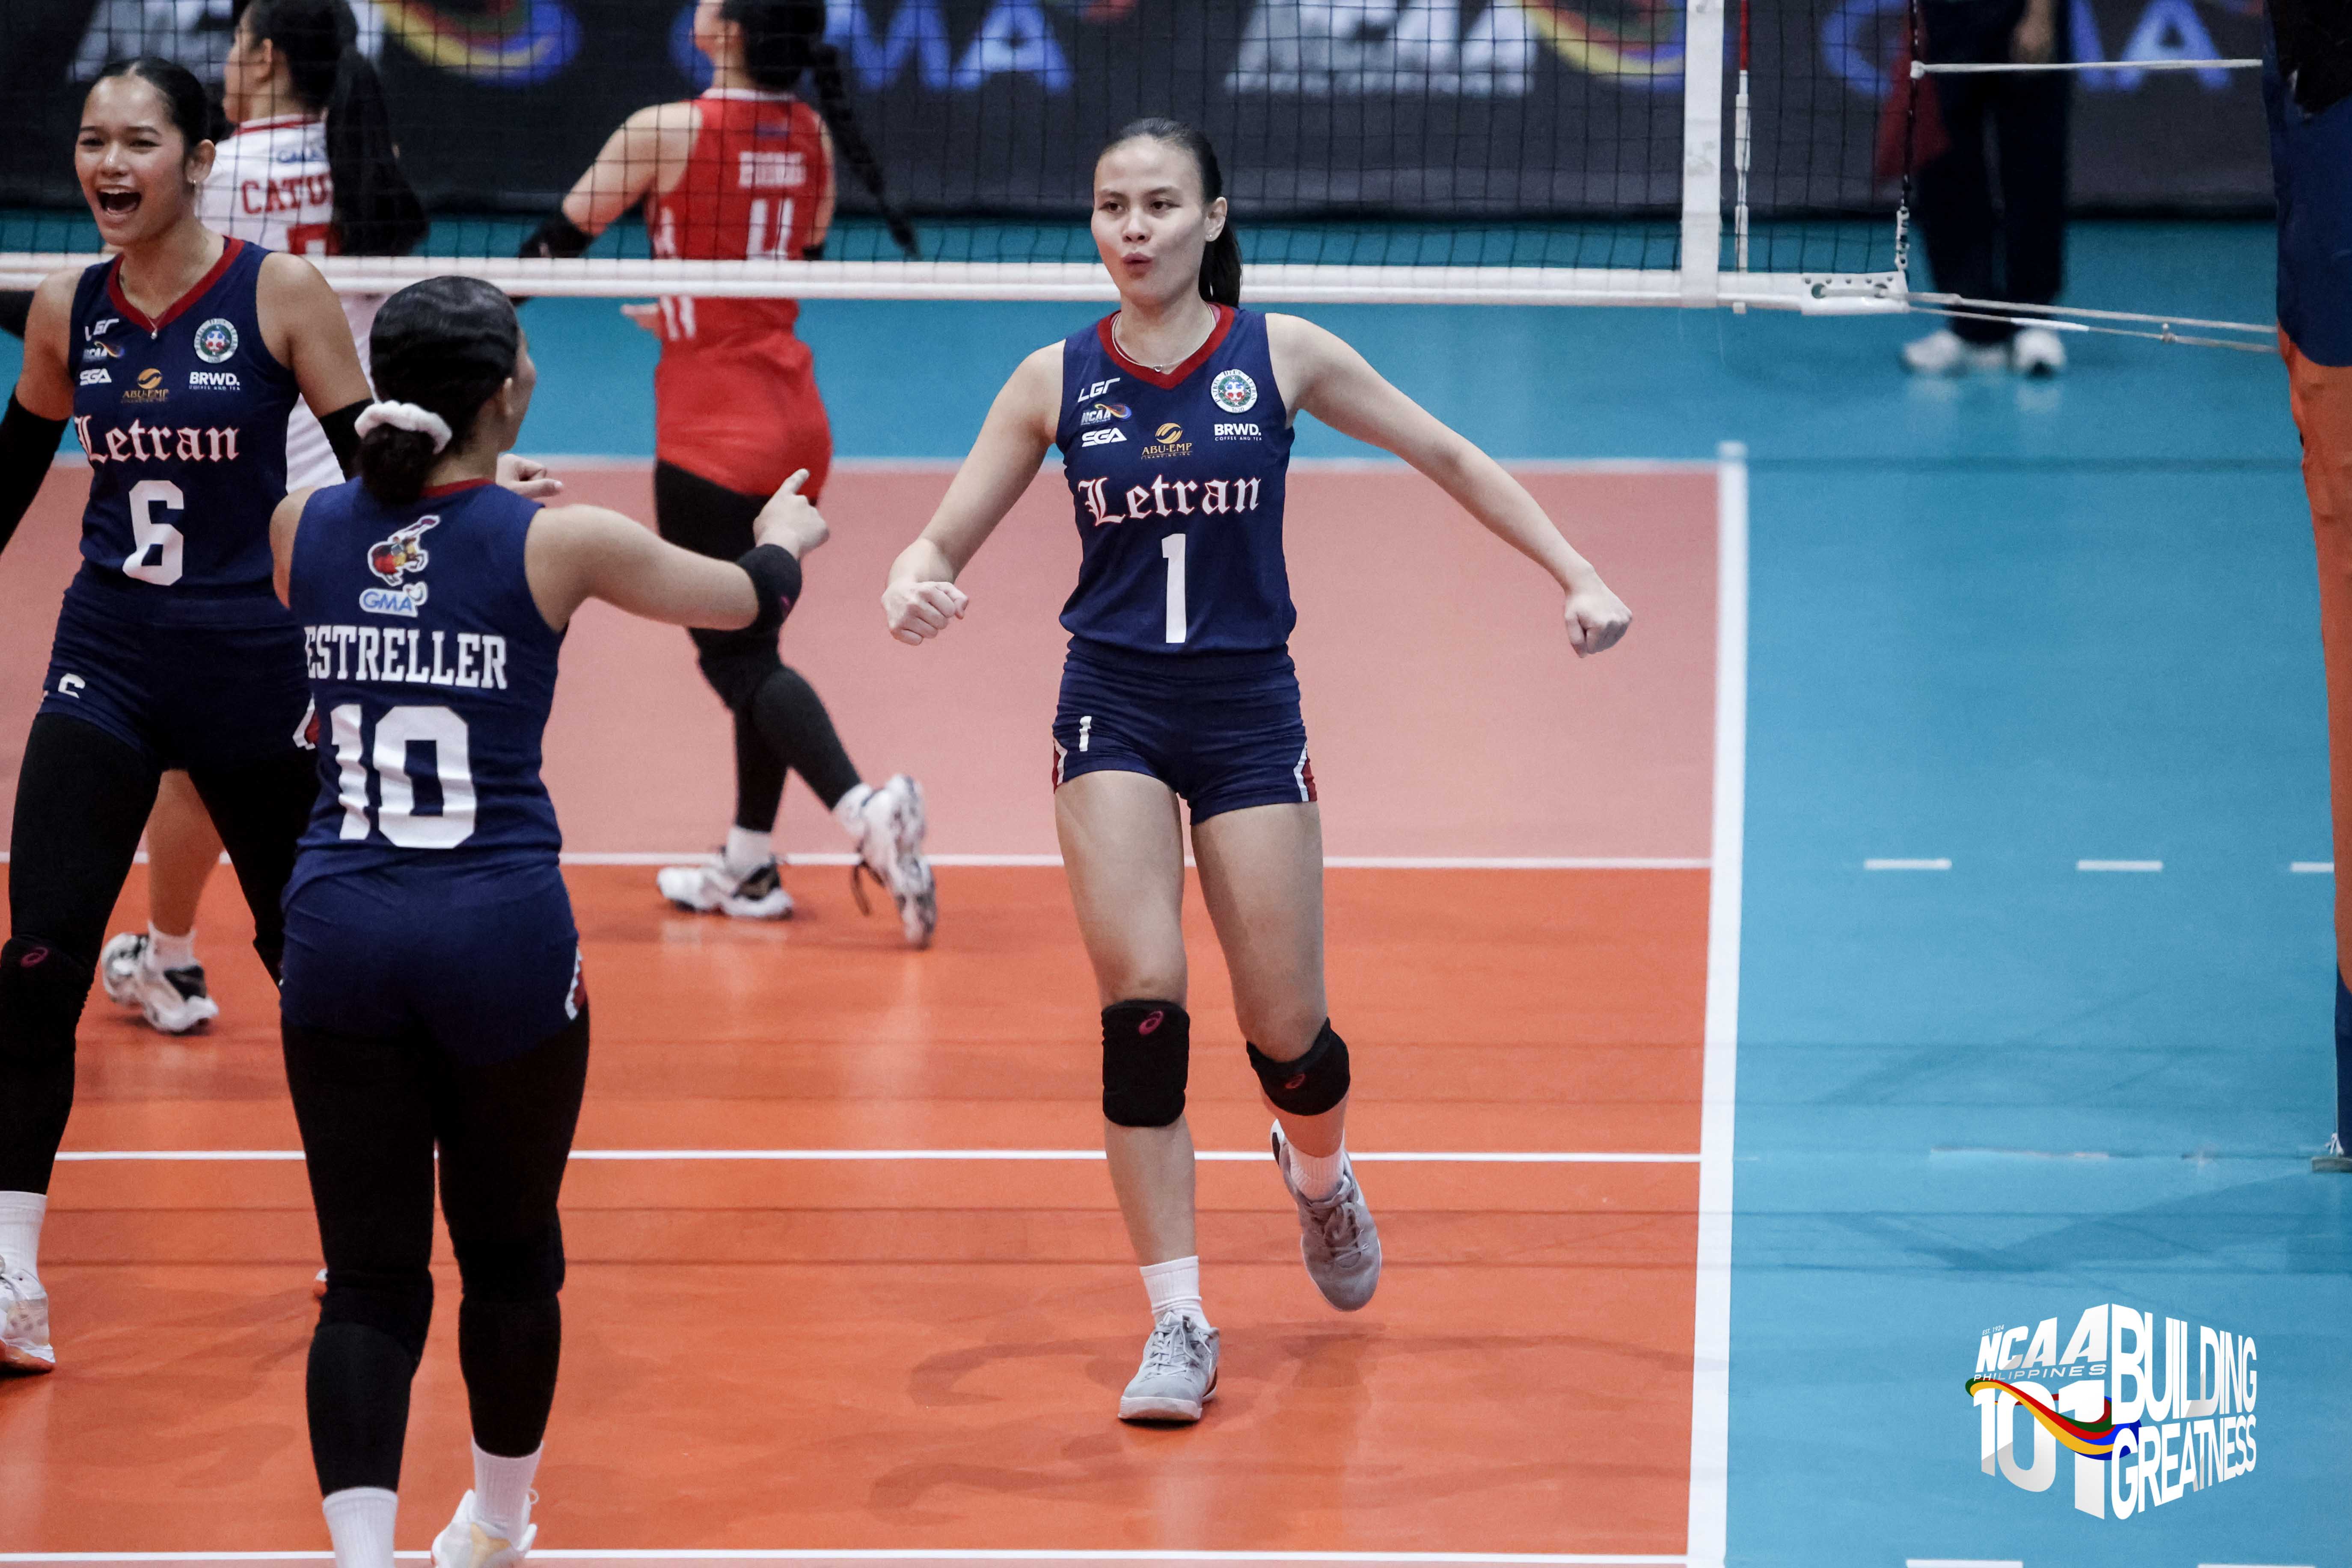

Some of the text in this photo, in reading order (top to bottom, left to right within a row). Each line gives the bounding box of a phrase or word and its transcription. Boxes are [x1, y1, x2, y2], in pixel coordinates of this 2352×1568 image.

[241, 172, 334, 214] CATU
[80, 368, 112, 386] SGA
[189, 371, 240, 386] BRWD.
[1081, 408, 1112, 424] NCAA
[1214, 423, 1262, 436] BRWD.
[74, 414, 240, 463] Letran
[1081, 427, 1128, 447] SGA
[1141, 442, 1192, 456] ABU-EMP
[1078, 474, 1262, 526] Letran
[122, 479, 184, 586] 6
[363, 591, 413, 612] GMA
[1161, 533, 1187, 644] 1
[304, 625, 508, 690] ESTRELLER
[1078, 715, 1092, 752] 1
[330, 703, 477, 849] 10
